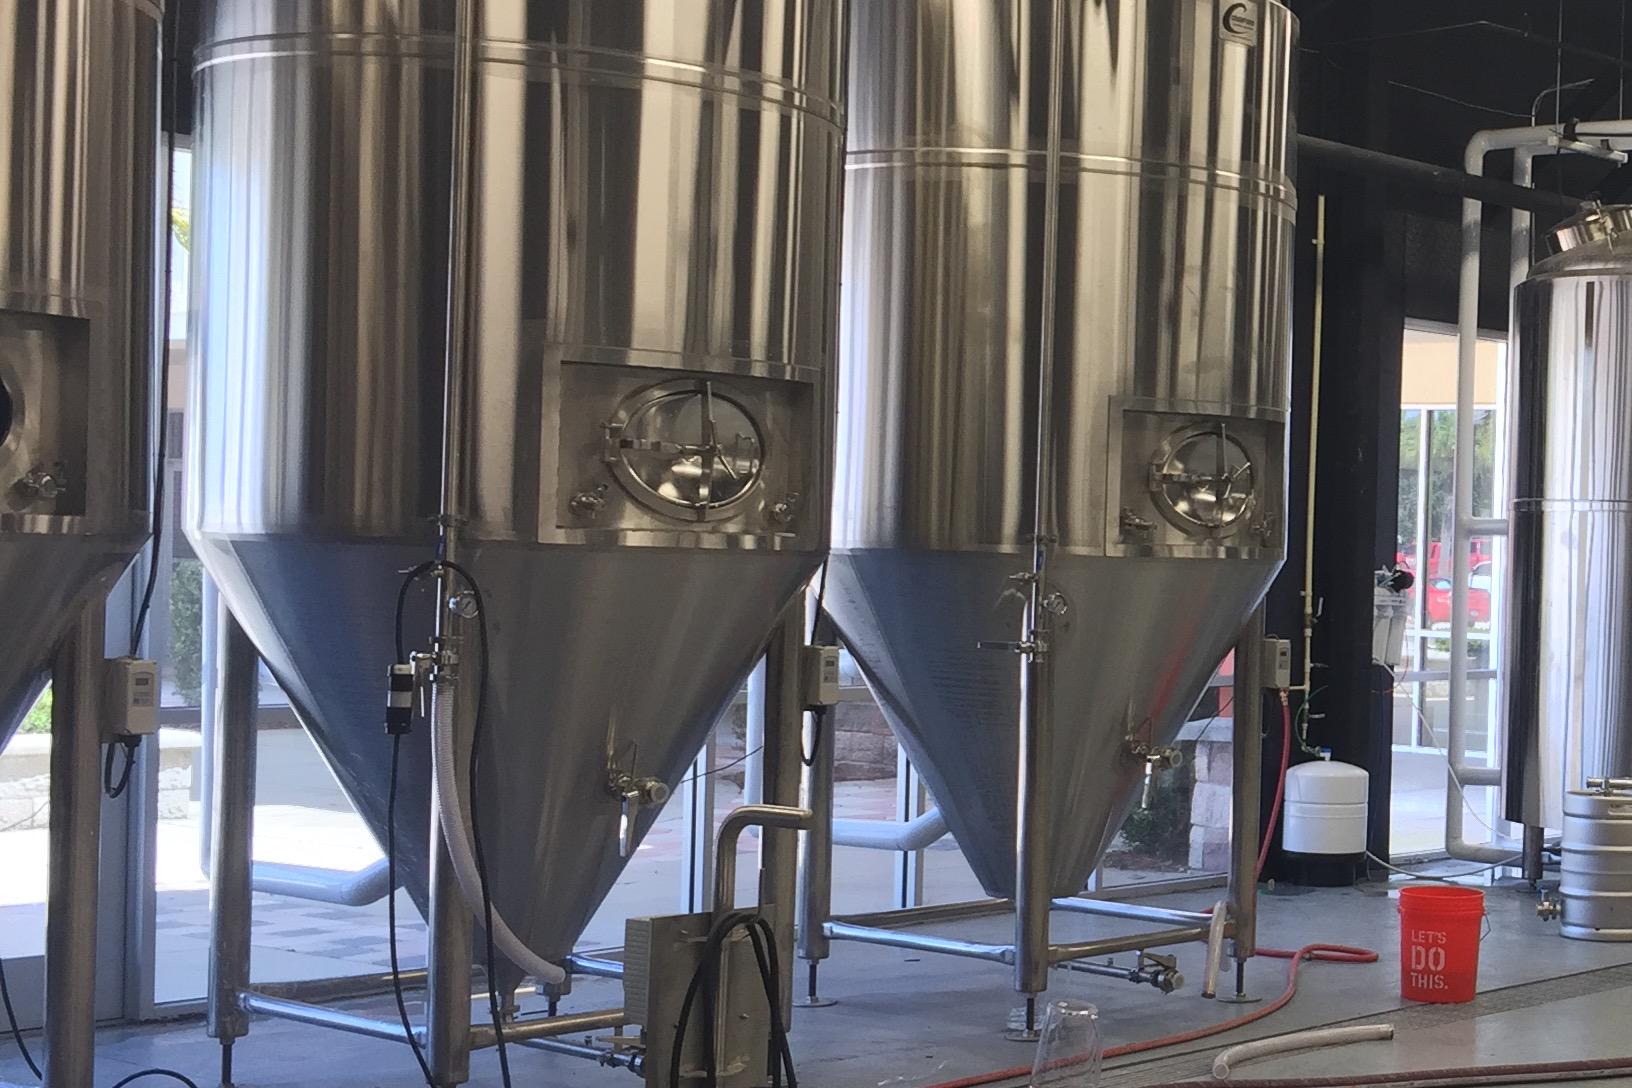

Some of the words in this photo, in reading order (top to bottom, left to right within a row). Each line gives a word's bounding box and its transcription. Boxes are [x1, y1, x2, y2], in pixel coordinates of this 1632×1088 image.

[1410, 930, 1447, 944] LET'S
[1411, 945, 1446, 971] DO
[1410, 972, 1449, 990] THIS.
